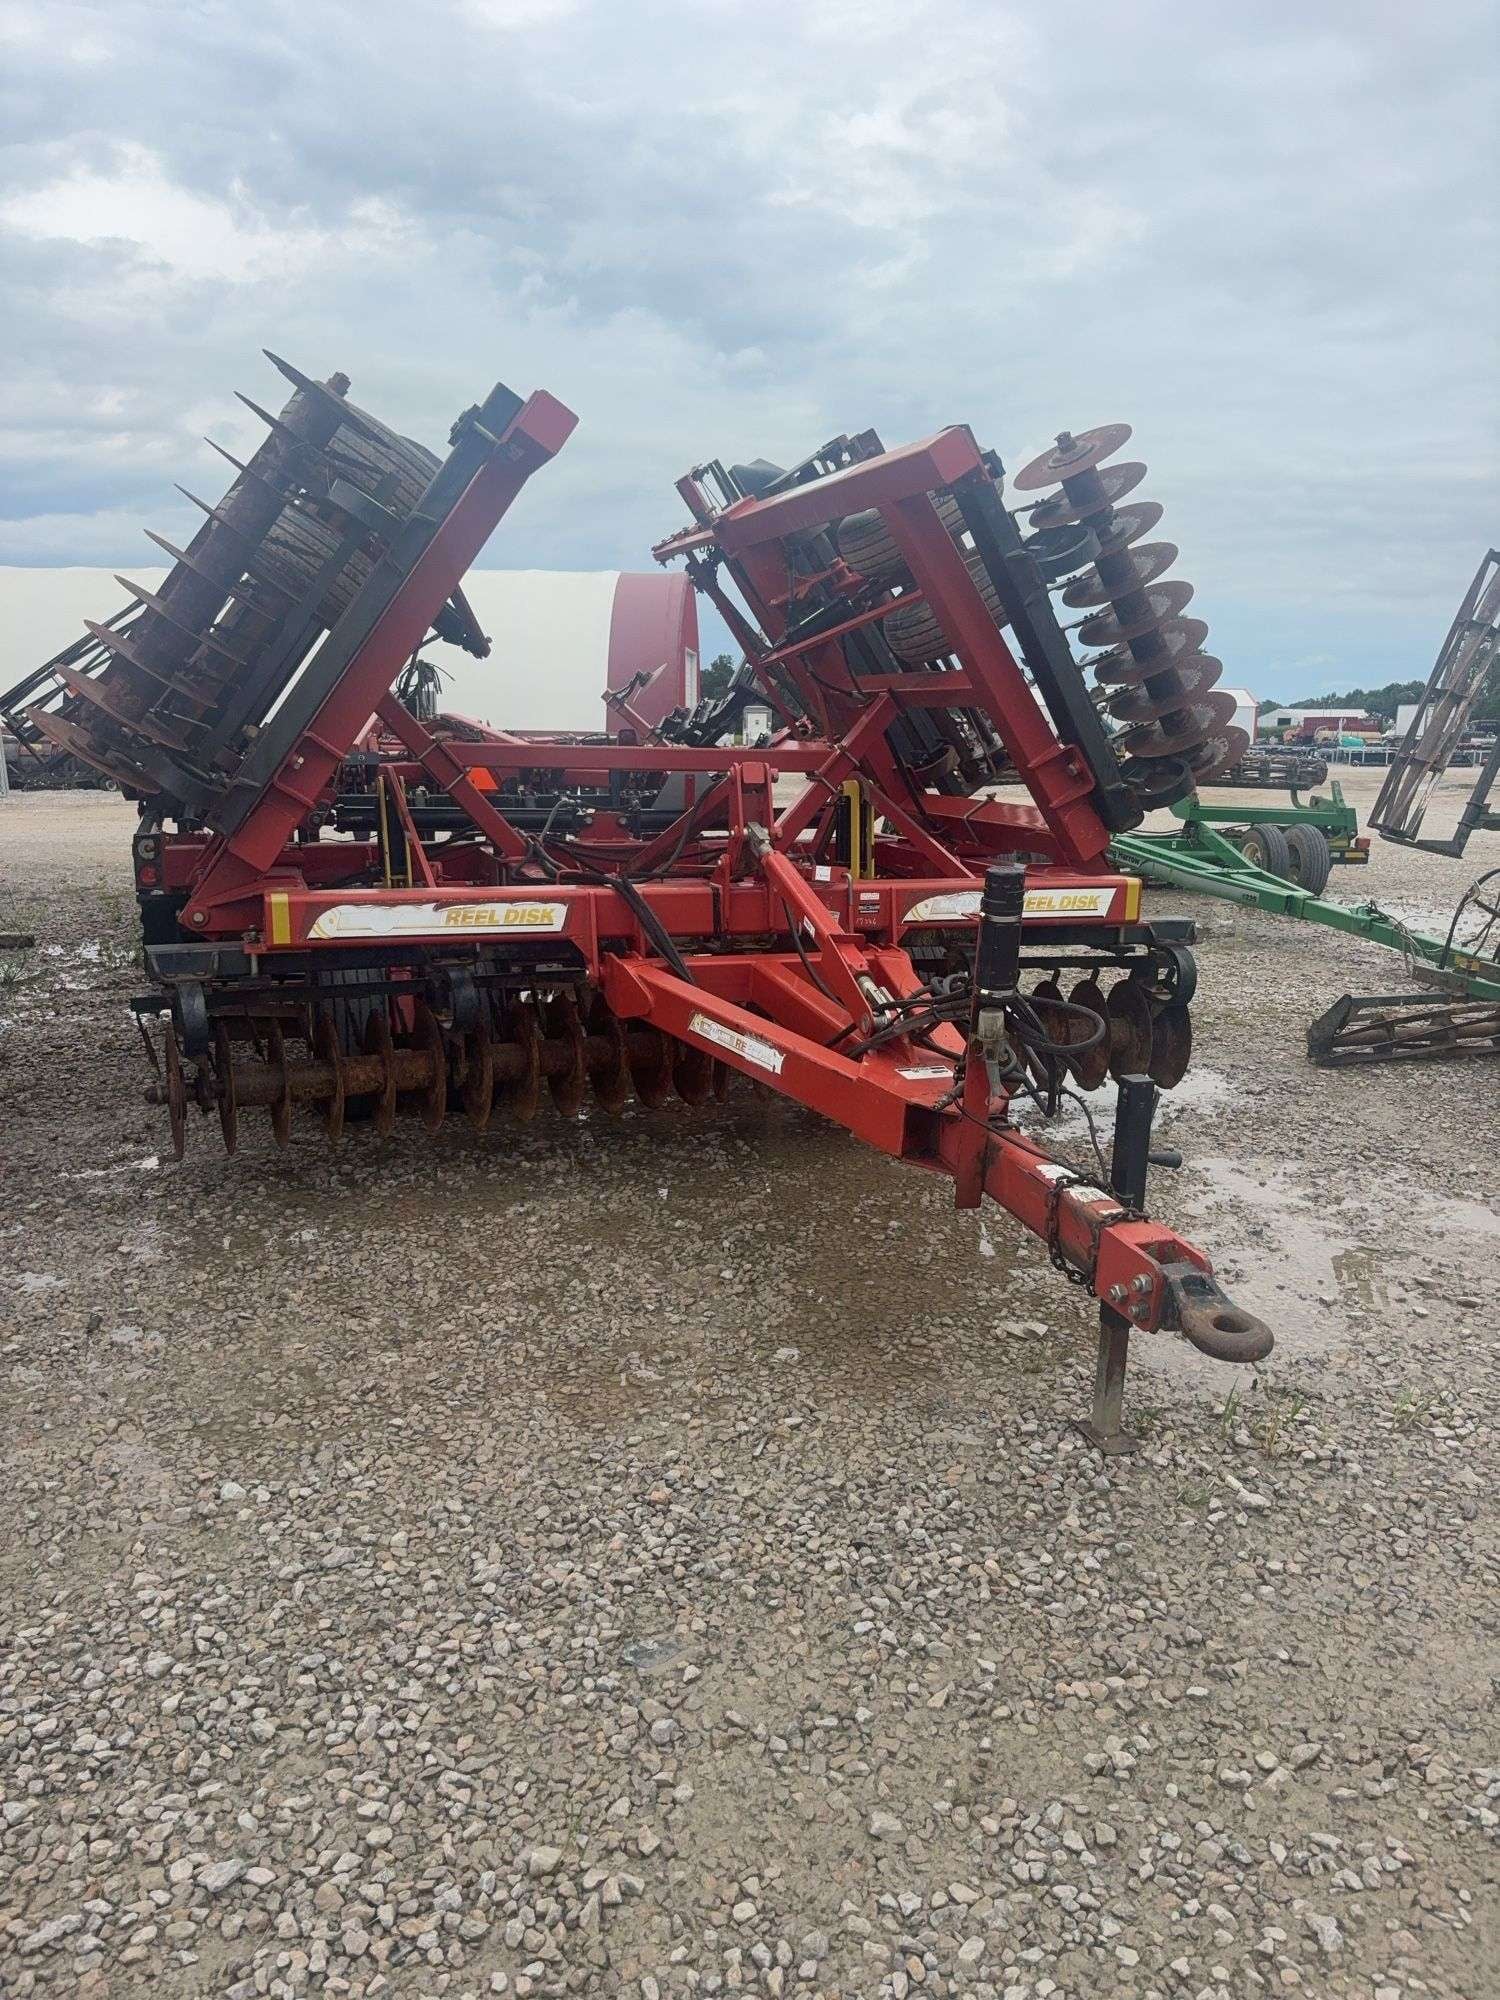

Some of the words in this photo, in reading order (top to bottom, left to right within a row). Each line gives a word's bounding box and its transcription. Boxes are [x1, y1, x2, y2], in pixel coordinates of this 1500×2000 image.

[1024, 894, 1057, 910] EEL
[1059, 894, 1101, 909] DISK
[445, 908, 500, 926] REEL
[503, 907, 557, 925] DISK
